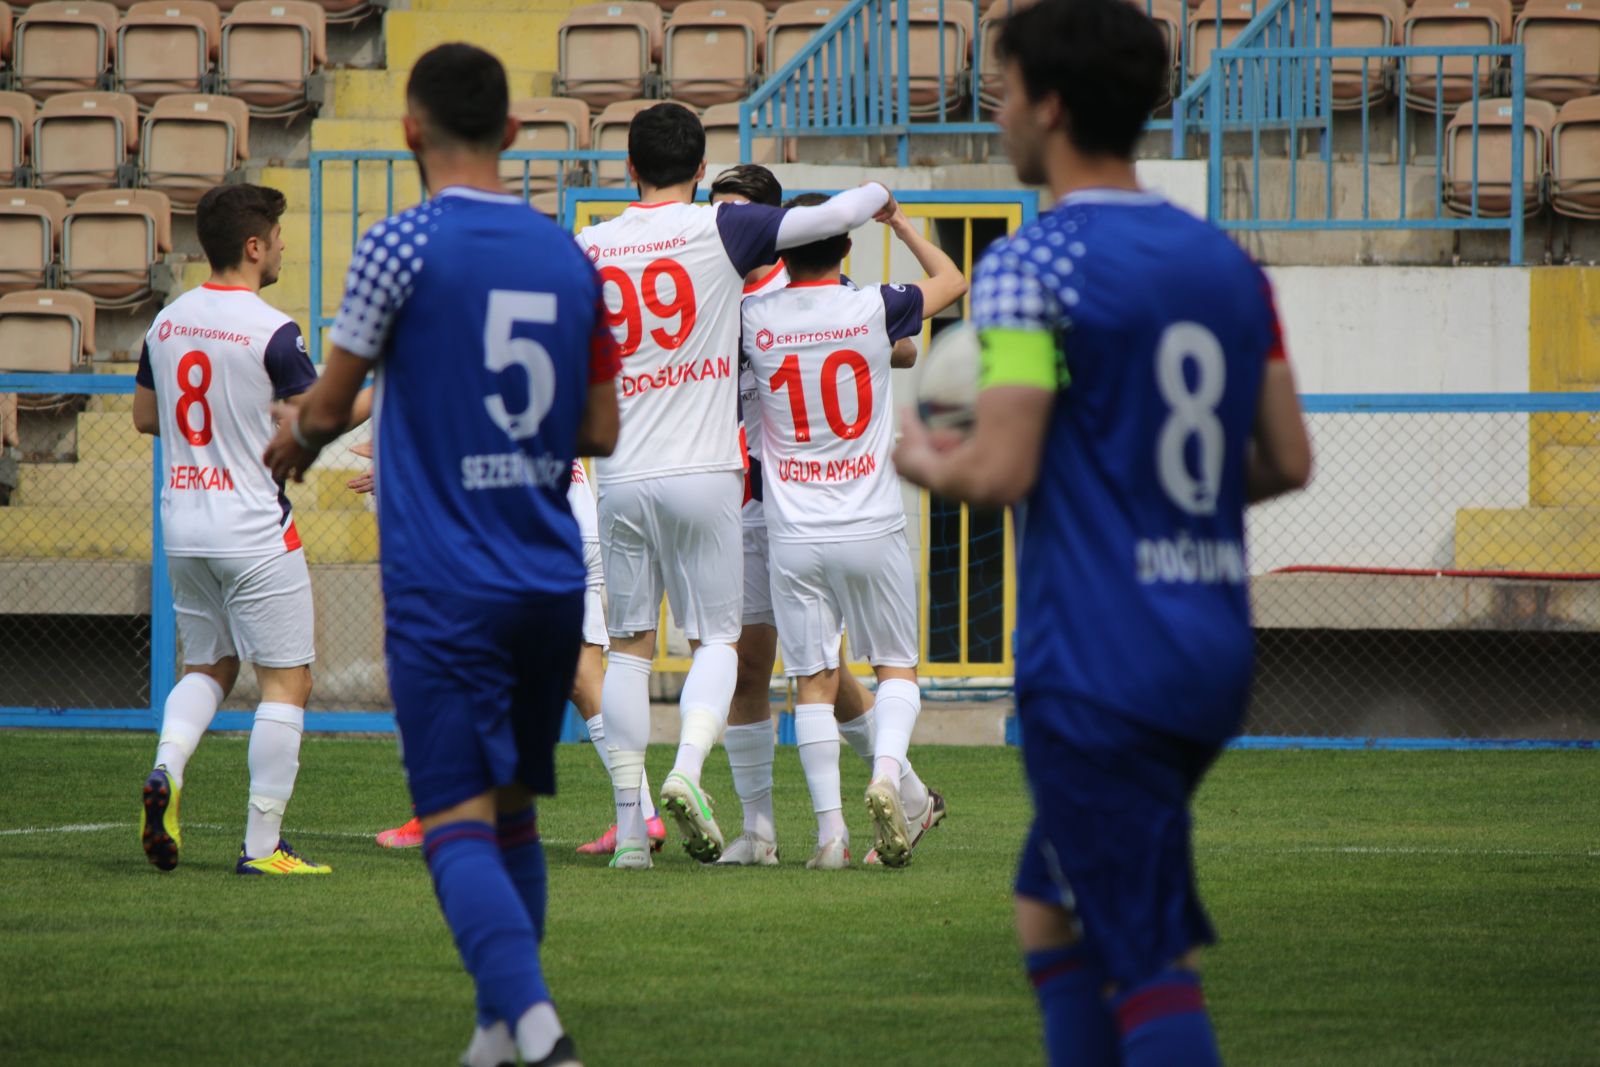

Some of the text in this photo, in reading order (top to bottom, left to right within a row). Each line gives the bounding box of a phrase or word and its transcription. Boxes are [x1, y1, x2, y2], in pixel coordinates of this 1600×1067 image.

[602, 236, 687, 258] CRIPTOSWAPS
[174, 325, 251, 346] CRIPTOSWAPS
[598, 257, 697, 358] 99
[776, 324, 869, 345] CRIPTOSWAPS
[176, 350, 213, 447] 8
[483, 288, 557, 442] 5
[622, 356, 730, 397] DOĞUKAN
[769, 349, 873, 443] 10
[1155, 320, 1227, 516] 8
[779, 451, 876, 483] UĞUR AYHAN
